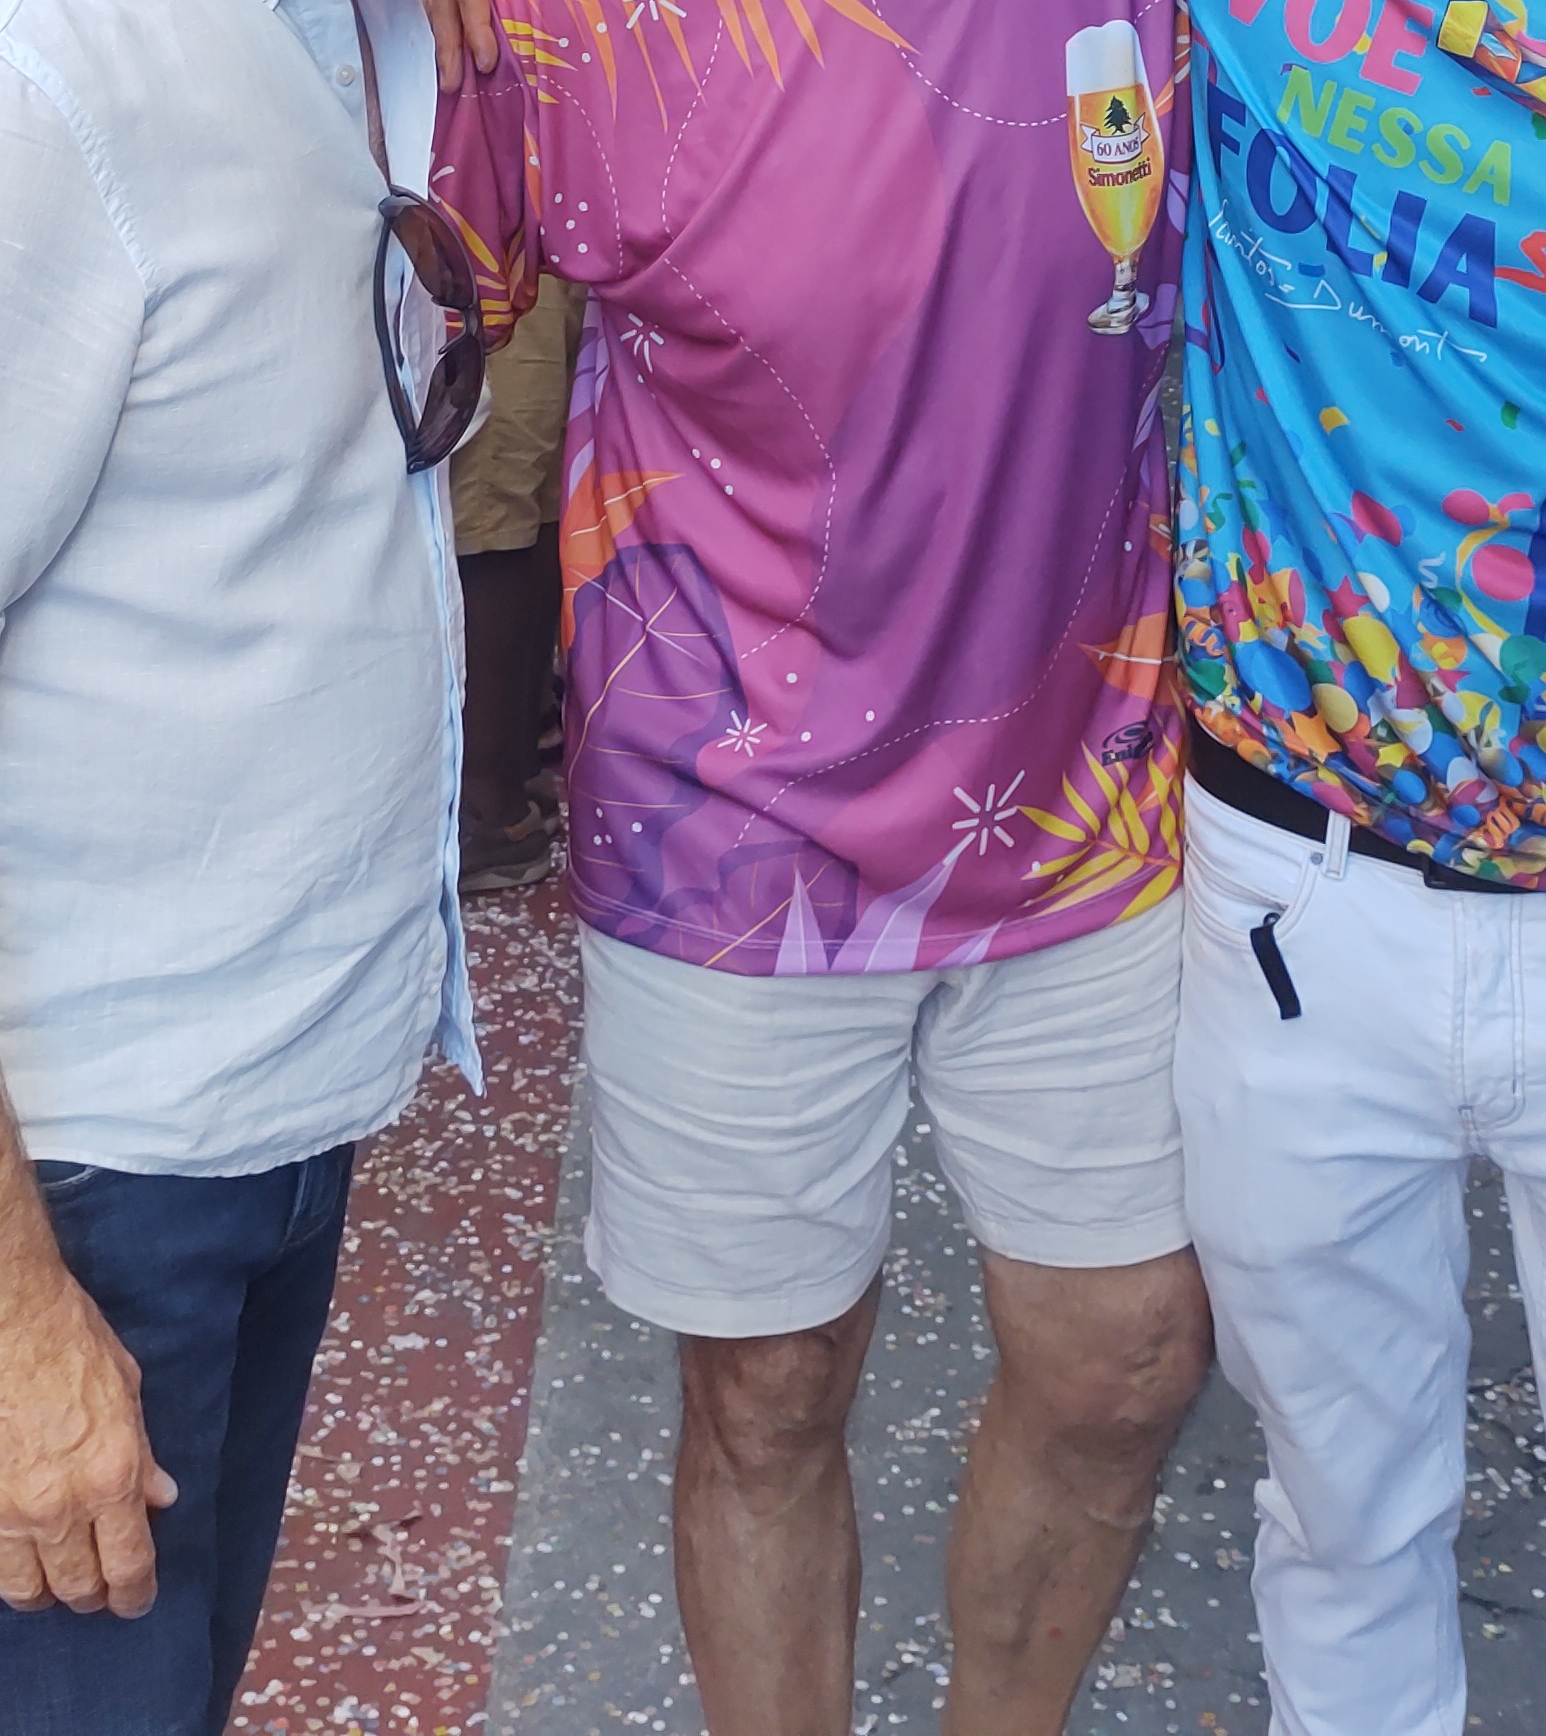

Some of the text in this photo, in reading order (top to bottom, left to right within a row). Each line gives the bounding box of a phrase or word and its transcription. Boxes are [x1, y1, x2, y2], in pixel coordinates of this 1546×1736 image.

[1096, 141, 1112, 156] 60
[1276, 65, 1514, 207] NESSA
[1087, 155, 1152, 187] Simonetti
